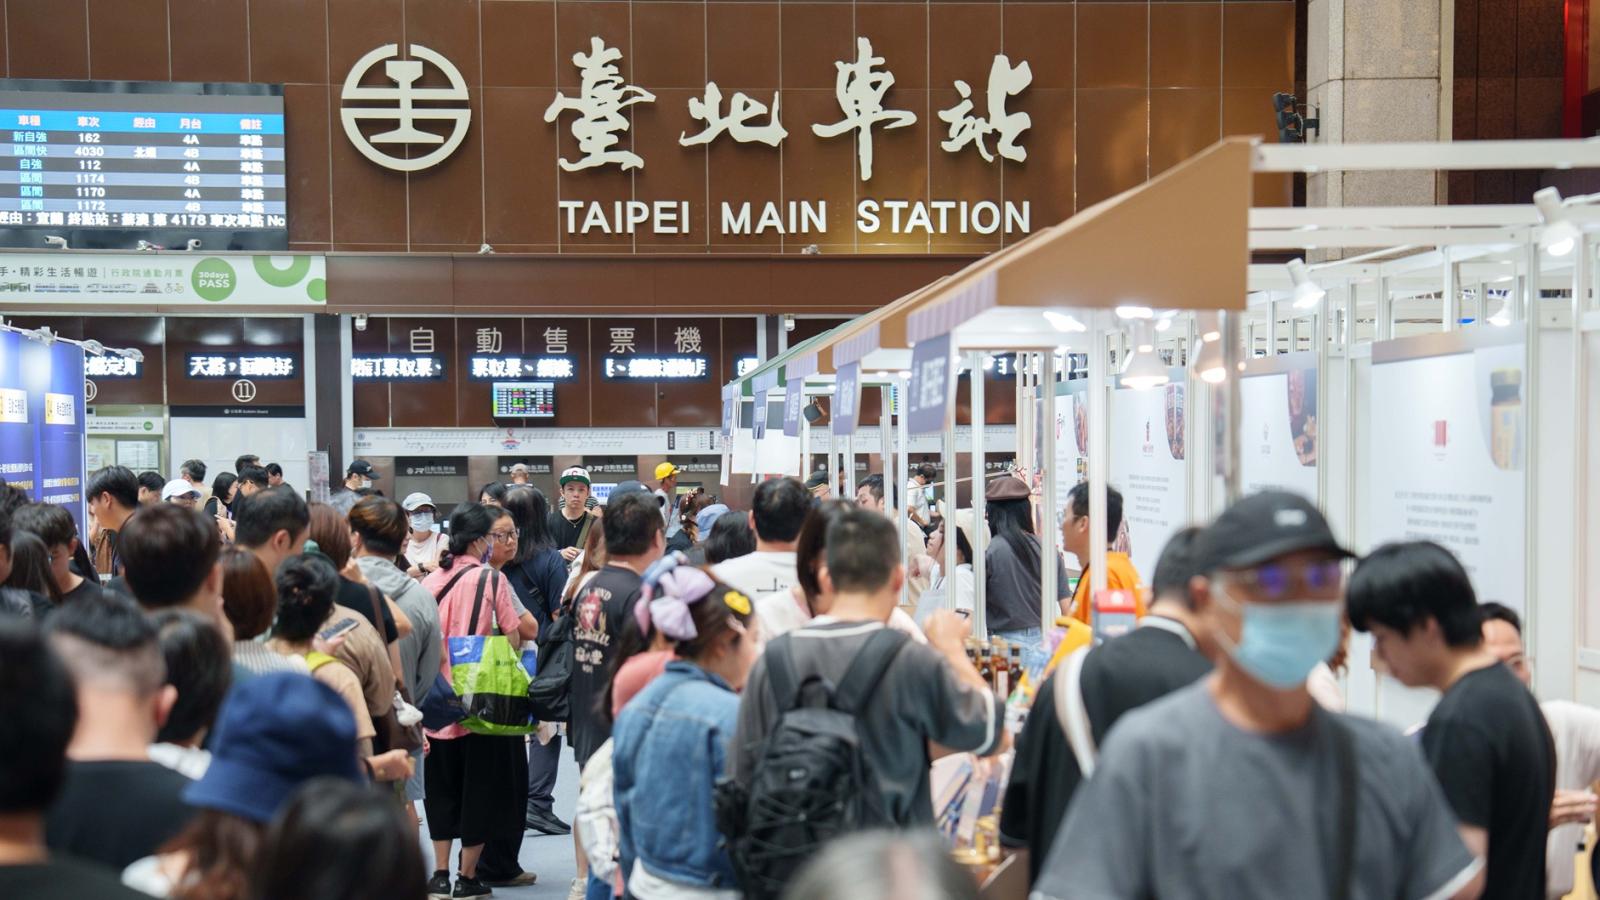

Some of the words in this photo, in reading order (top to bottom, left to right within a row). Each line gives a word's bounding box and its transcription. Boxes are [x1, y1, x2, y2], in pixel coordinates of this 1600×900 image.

[543, 36, 1034, 181] 臺北車站
[180, 118, 202, 129] 月台
[78, 133, 100, 143] 162
[183, 135, 199, 145] 4A
[75, 147, 104, 157] 4030
[184, 149, 199, 158] 4B
[79, 160, 101, 170] 112
[184, 162, 200, 172] 4A
[76, 174, 104, 184] 1174
[184, 175, 200, 185] 4B
[76, 188, 105, 198] 1170
[184, 189, 201, 199] 4A
[77, 201, 106, 211] 1172
[185, 202, 201, 212] 4B
[170, 214, 206, 225] 4178
[559, 200, 690, 233] TAIPEI
[721, 200, 827, 234] MAIN
[856, 199, 1031, 234] STATION
[199, 271, 229, 280] 30days
[199, 279, 230, 288] PASS
[409, 326, 702, 354] 自動售票機
